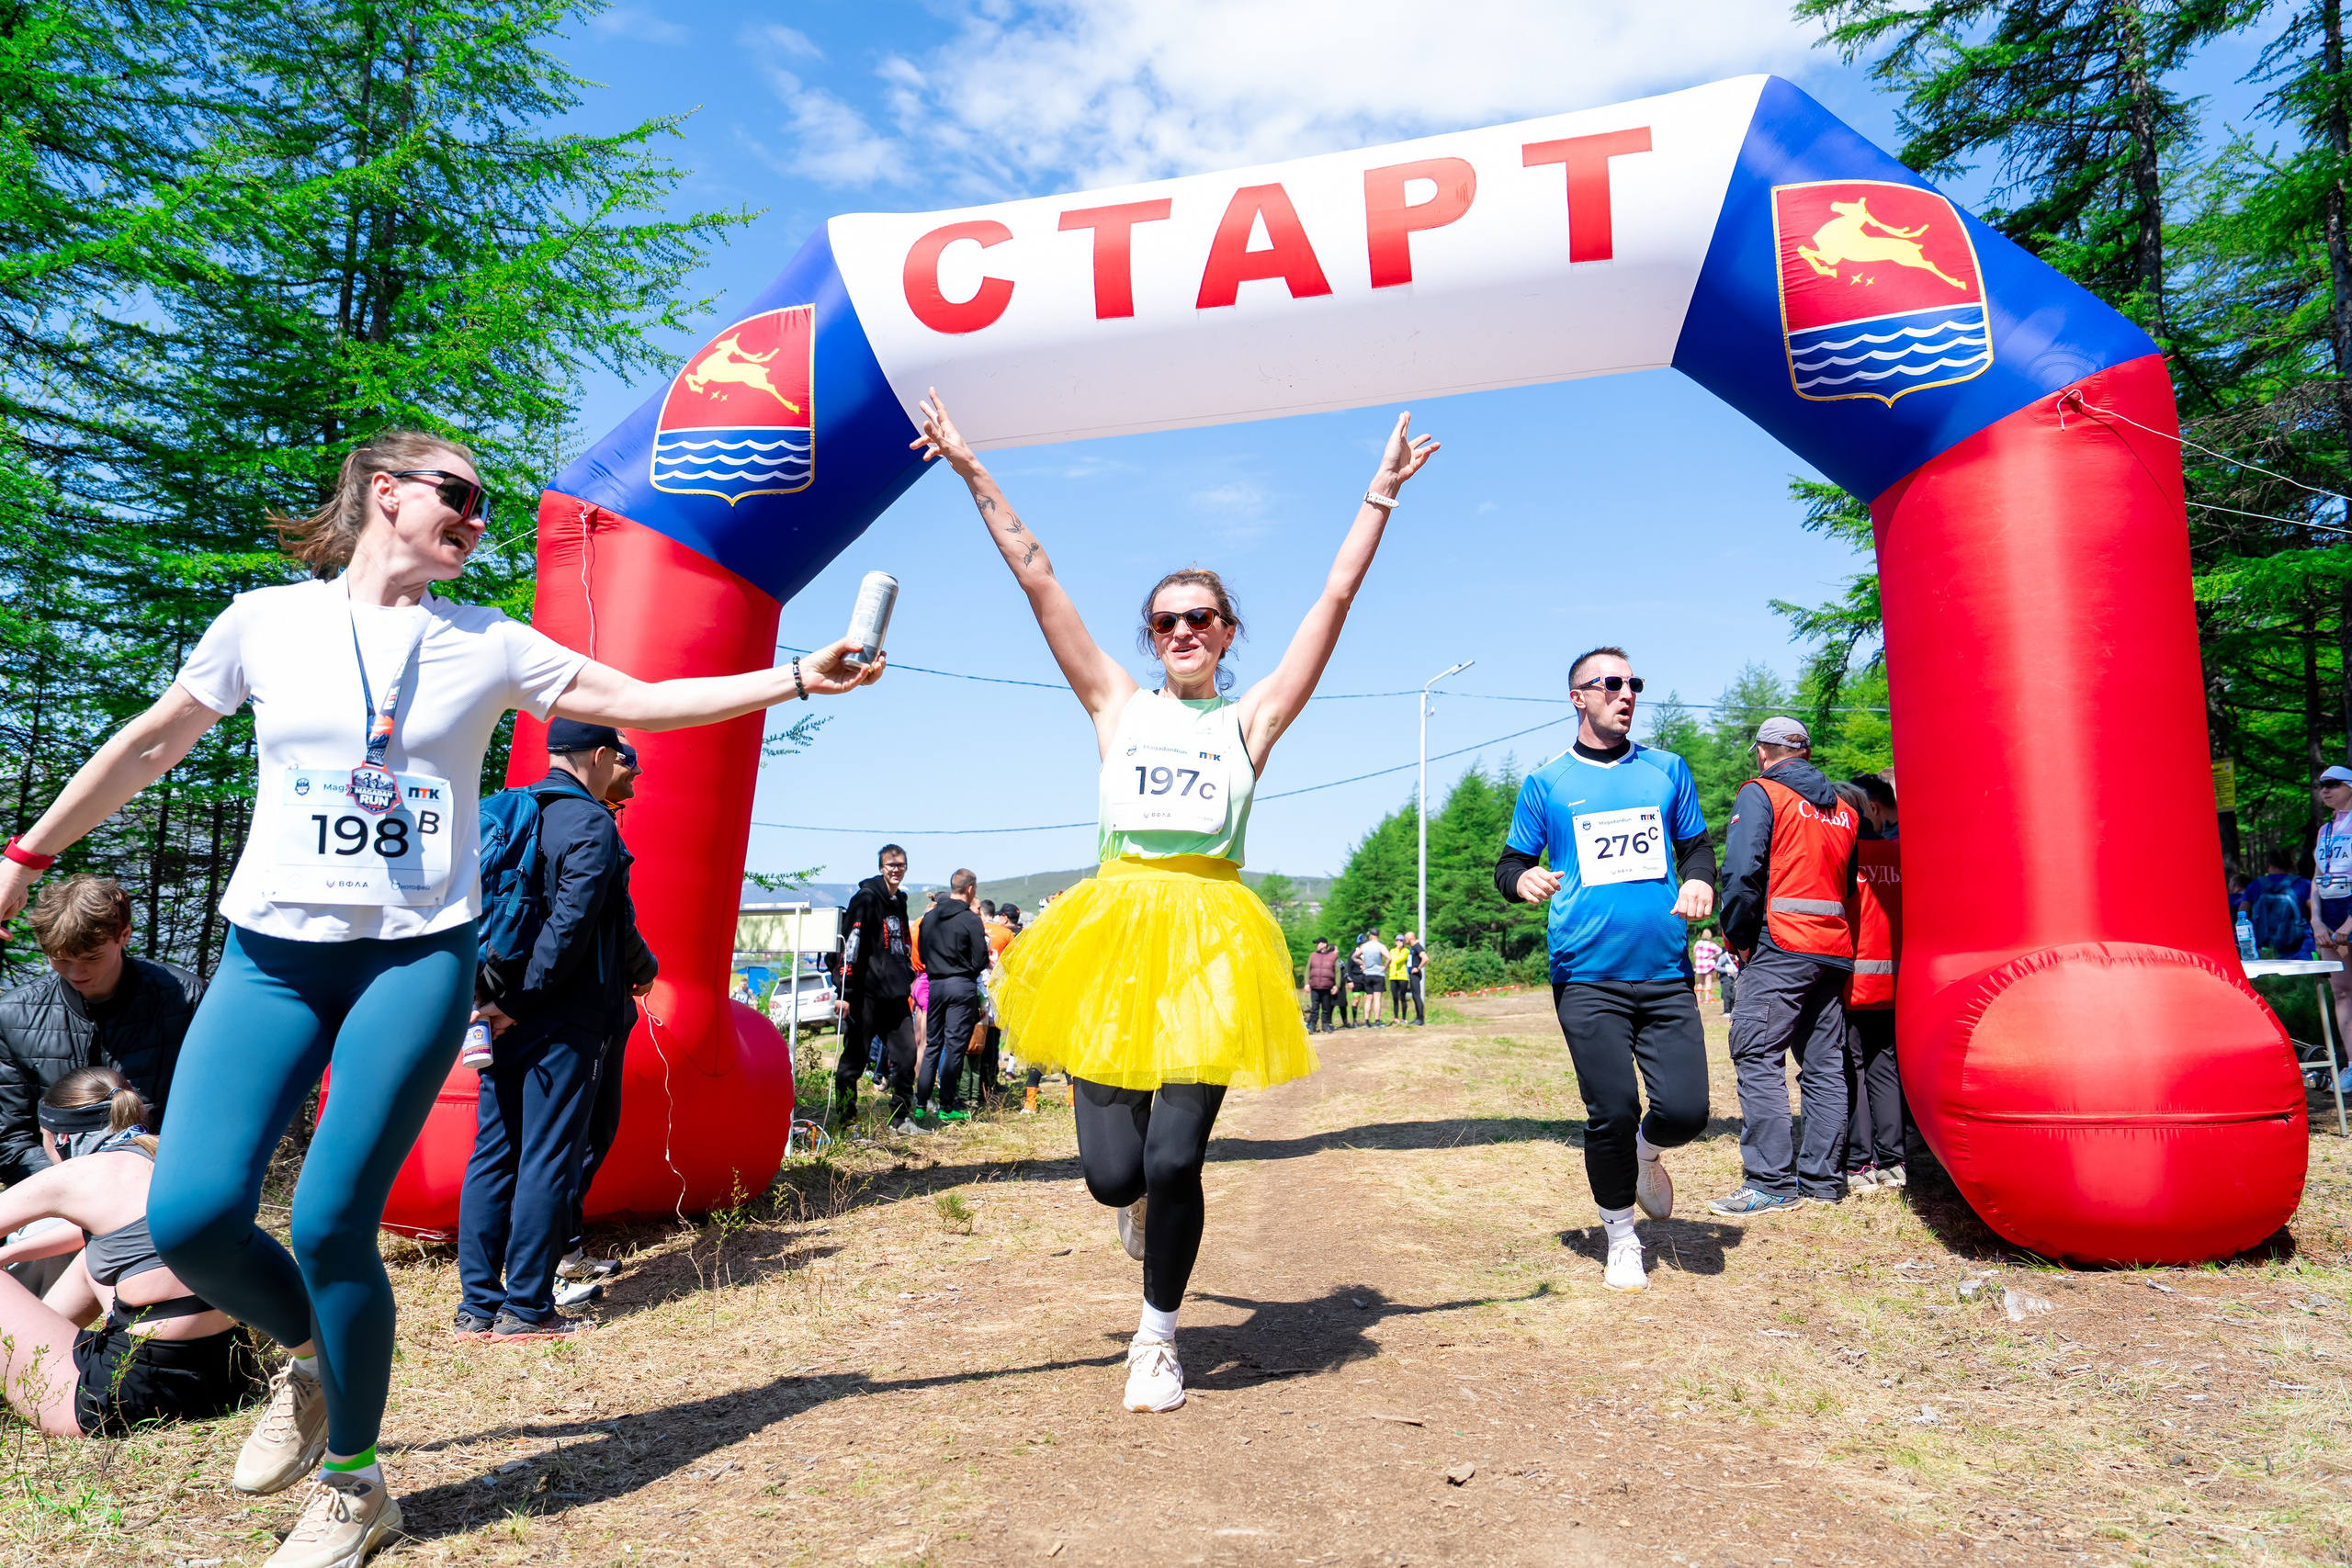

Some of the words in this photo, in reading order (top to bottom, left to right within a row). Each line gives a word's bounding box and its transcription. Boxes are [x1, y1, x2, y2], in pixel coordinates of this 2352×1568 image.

[903, 126, 1652, 335] СТАРТ
[1199, 751, 1221, 761] ПТК
[355, 787, 393, 798] MAGADAN
[408, 786, 439, 799] ПТК
[359, 795, 390, 807] RUN
[1857, 865, 1901, 886] СУДЬ
